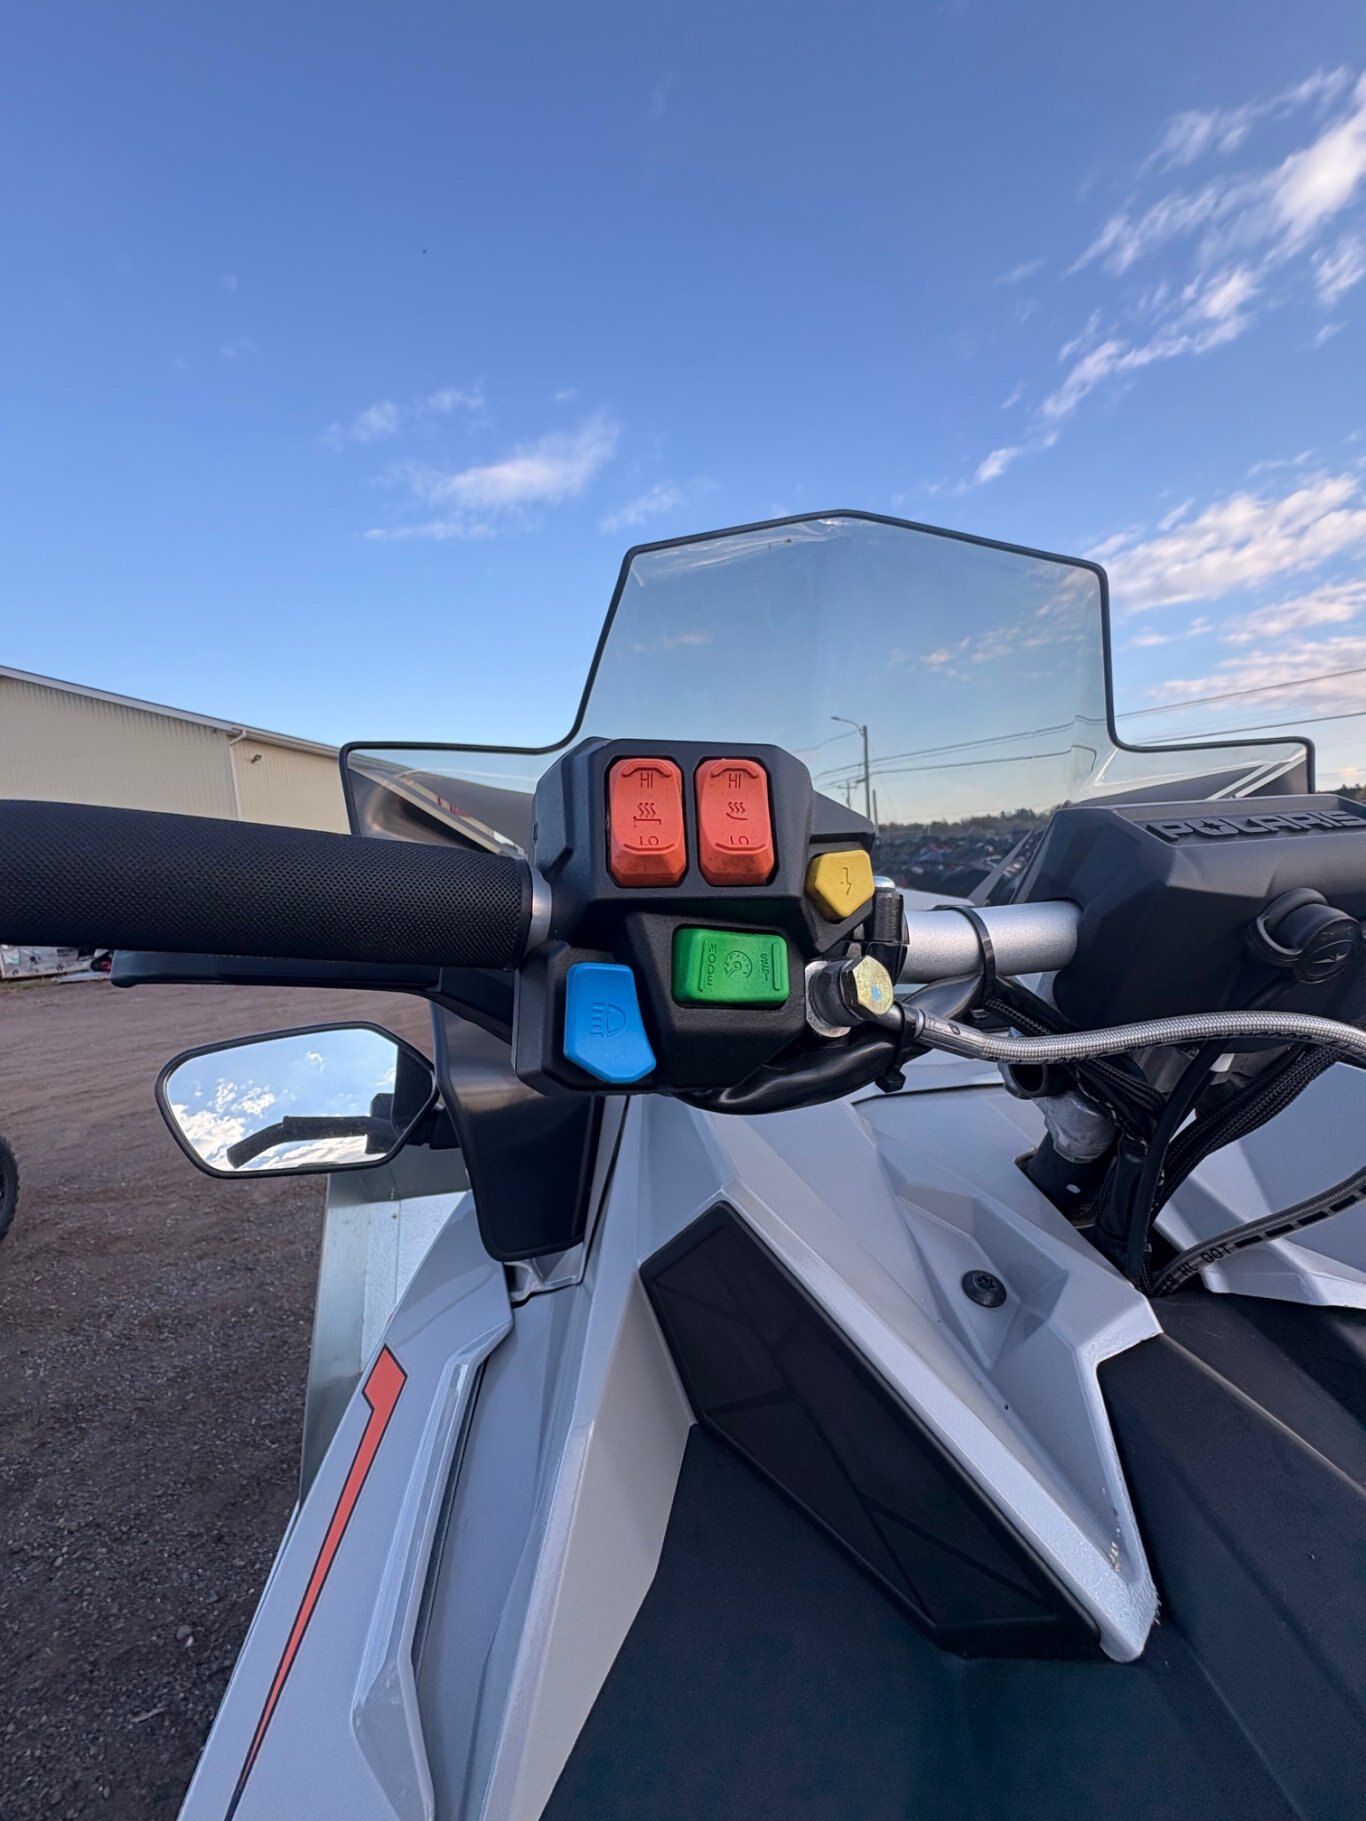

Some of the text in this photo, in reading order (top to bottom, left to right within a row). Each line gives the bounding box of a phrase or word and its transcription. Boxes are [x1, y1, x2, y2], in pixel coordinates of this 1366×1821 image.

[640, 772, 653, 789] HI
[728, 773, 741, 789] HI
[1146, 810, 1366, 843] POLARIS
[639, 835, 659, 846] LO
[707, 943, 717, 986] MODE
[760, 952, 769, 982] SET
